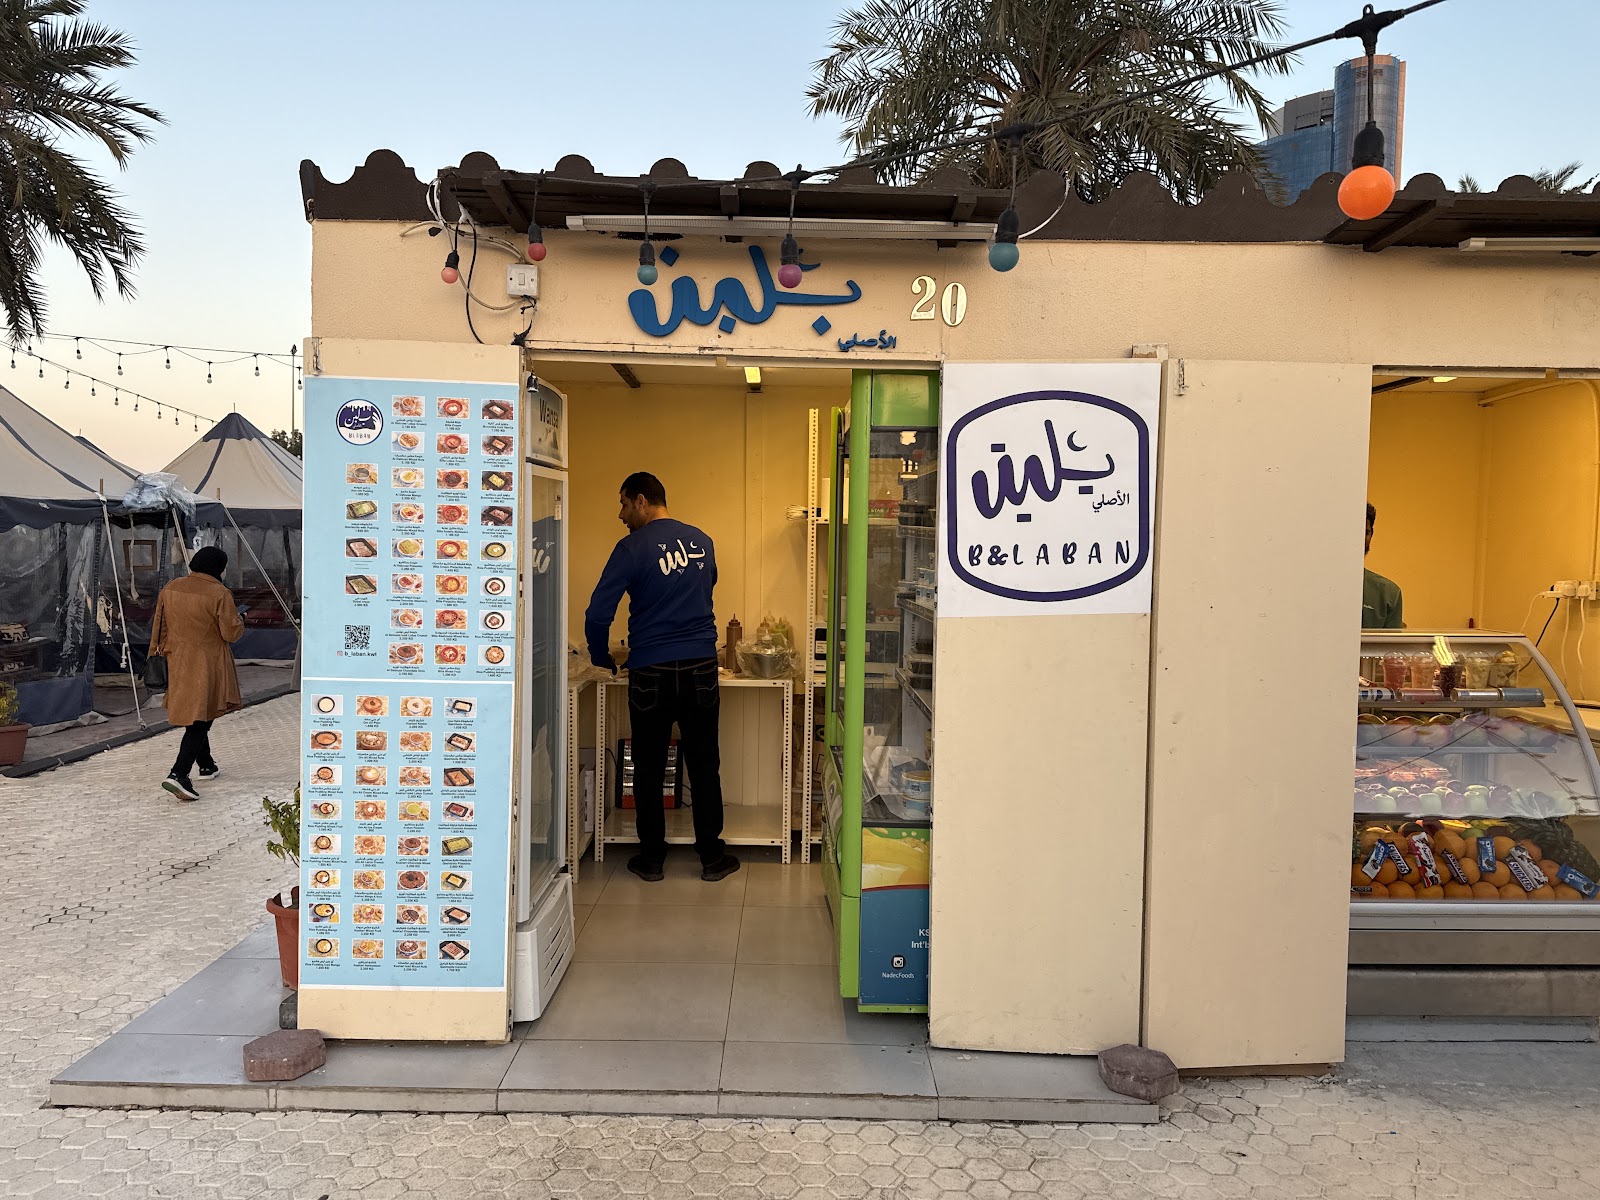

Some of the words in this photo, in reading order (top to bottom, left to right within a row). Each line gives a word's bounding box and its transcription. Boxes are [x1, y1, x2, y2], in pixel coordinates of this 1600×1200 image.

[909, 275, 968, 328] 20
[837, 329, 897, 352] الأصلي
[539, 398, 559, 429] Wansa
[1092, 490, 1130, 513] الأصلي
[1509, 862, 1533, 890] SNICKERS
[881, 971, 915, 979] NadecFoods
